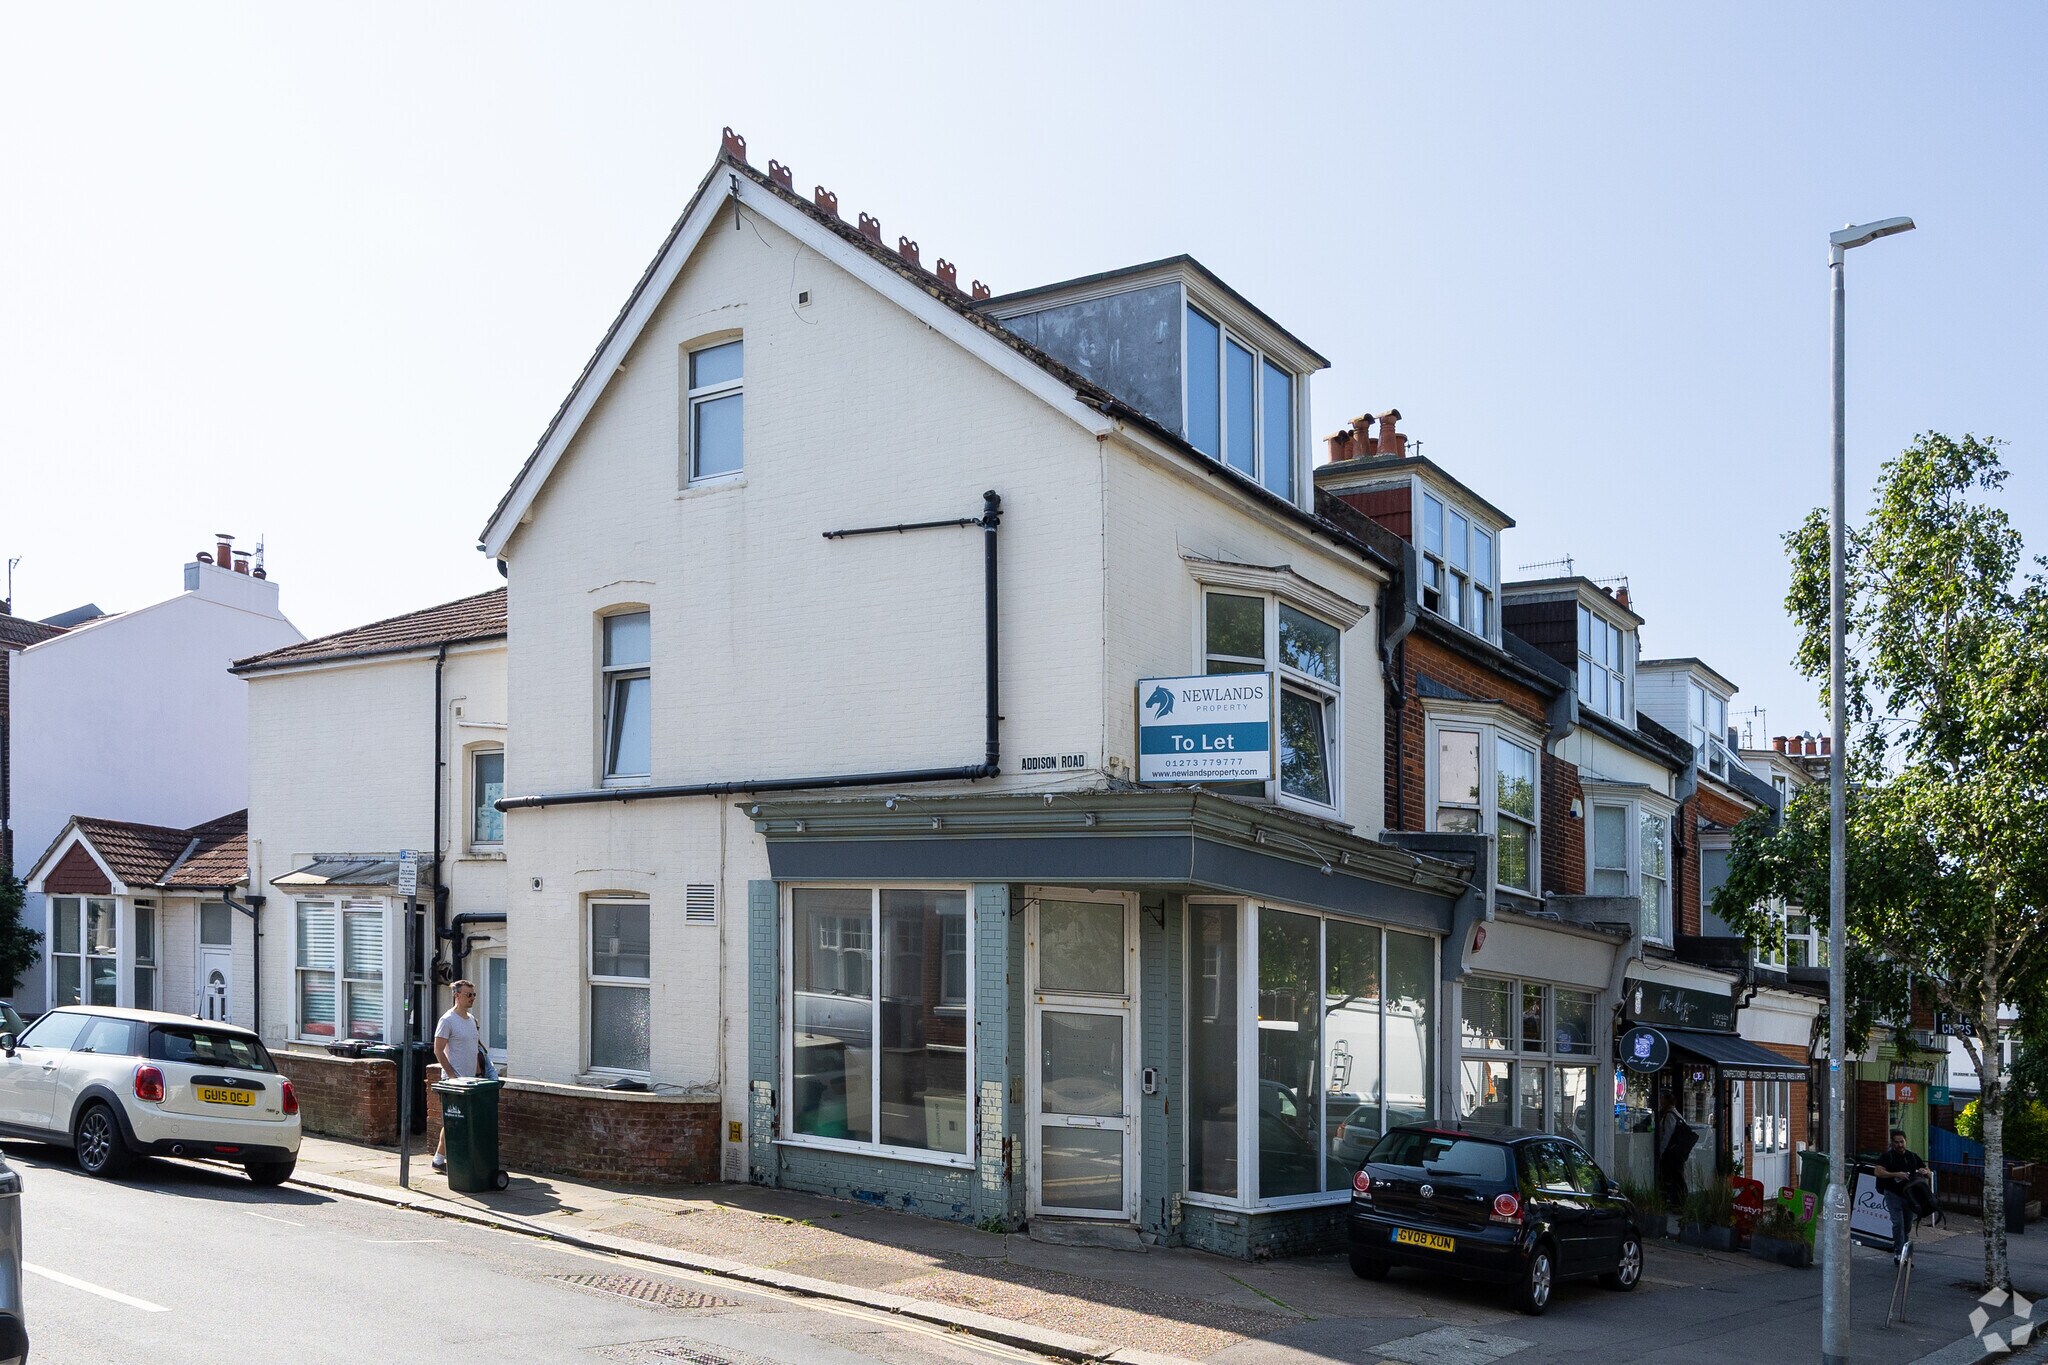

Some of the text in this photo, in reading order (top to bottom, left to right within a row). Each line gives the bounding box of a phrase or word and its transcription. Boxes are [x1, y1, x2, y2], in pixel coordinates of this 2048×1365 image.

[1182, 686, 1263, 702] NEWLANDS
[1196, 704, 1248, 712] PROPERTY
[1171, 734, 1235, 751] To Let
[1021, 754, 1085, 770] ADDISON ROAD
[1165, 758, 1243, 768] 01273 779777
[1151, 768, 1258, 778] www.newlandsproperty.com
[1942, 1023, 1972, 1035] CHPS
[204, 1089, 228, 1101] GU15
[1858, 1191, 1890, 1212] Real
[1732, 1203, 1762, 1215] hirsty?
[1400, 1229, 1452, 1249] GV08 XUN
